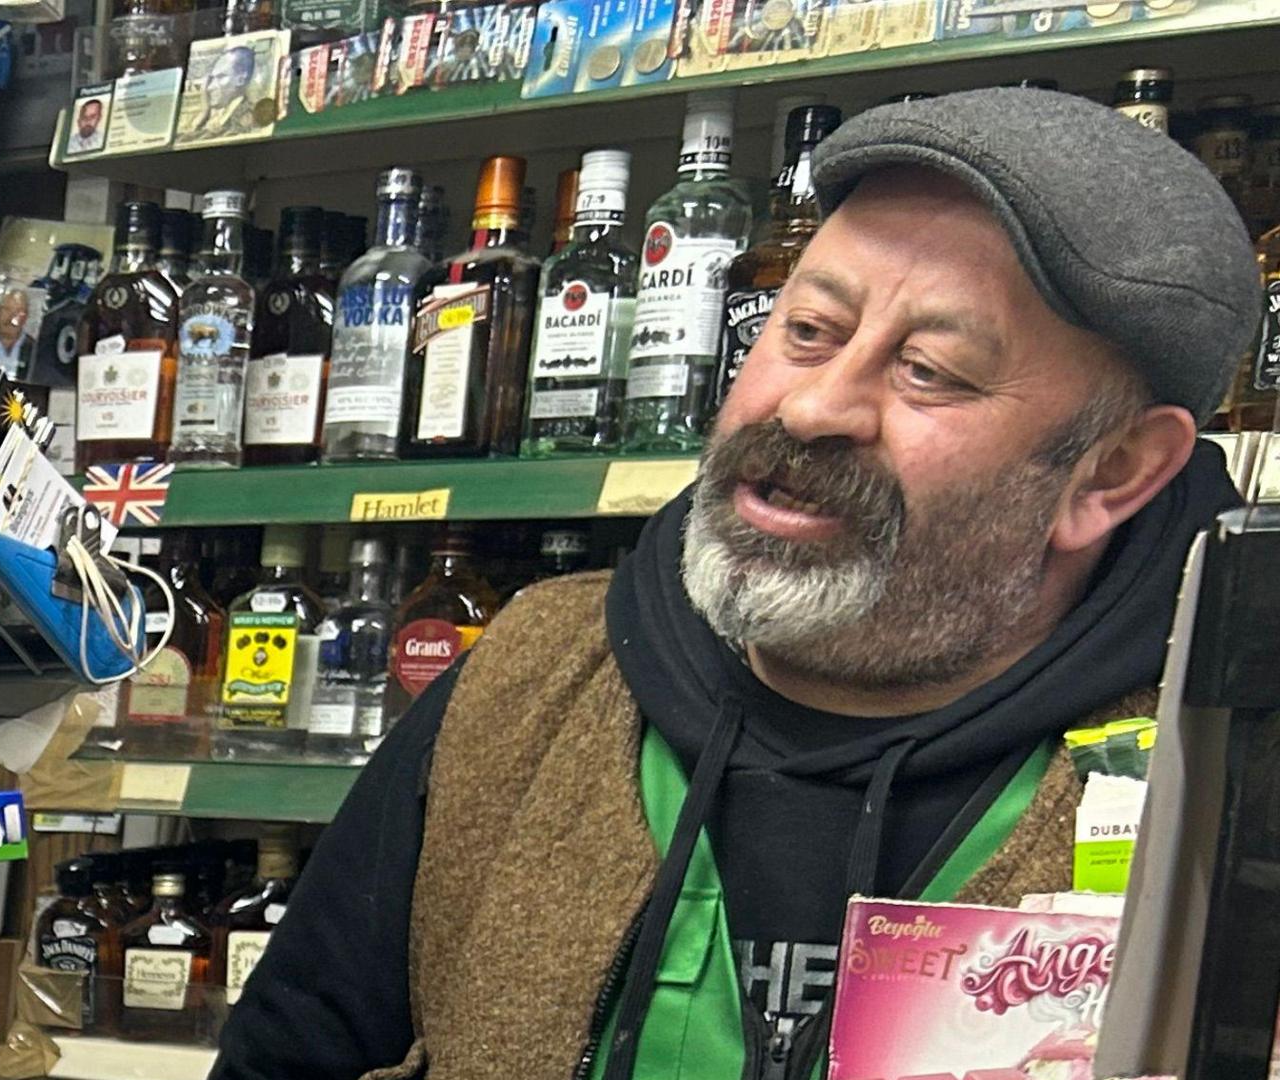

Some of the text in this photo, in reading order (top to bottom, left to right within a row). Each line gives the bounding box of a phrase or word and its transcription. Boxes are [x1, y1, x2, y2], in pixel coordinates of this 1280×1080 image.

[641, 263, 693, 290] CARDÍ
[342, 307, 405, 327] VODKA
[361, 495, 443, 520] Hamlet
[848, 940, 967, 980] SWEET
[961, 926, 1116, 997] Ange
